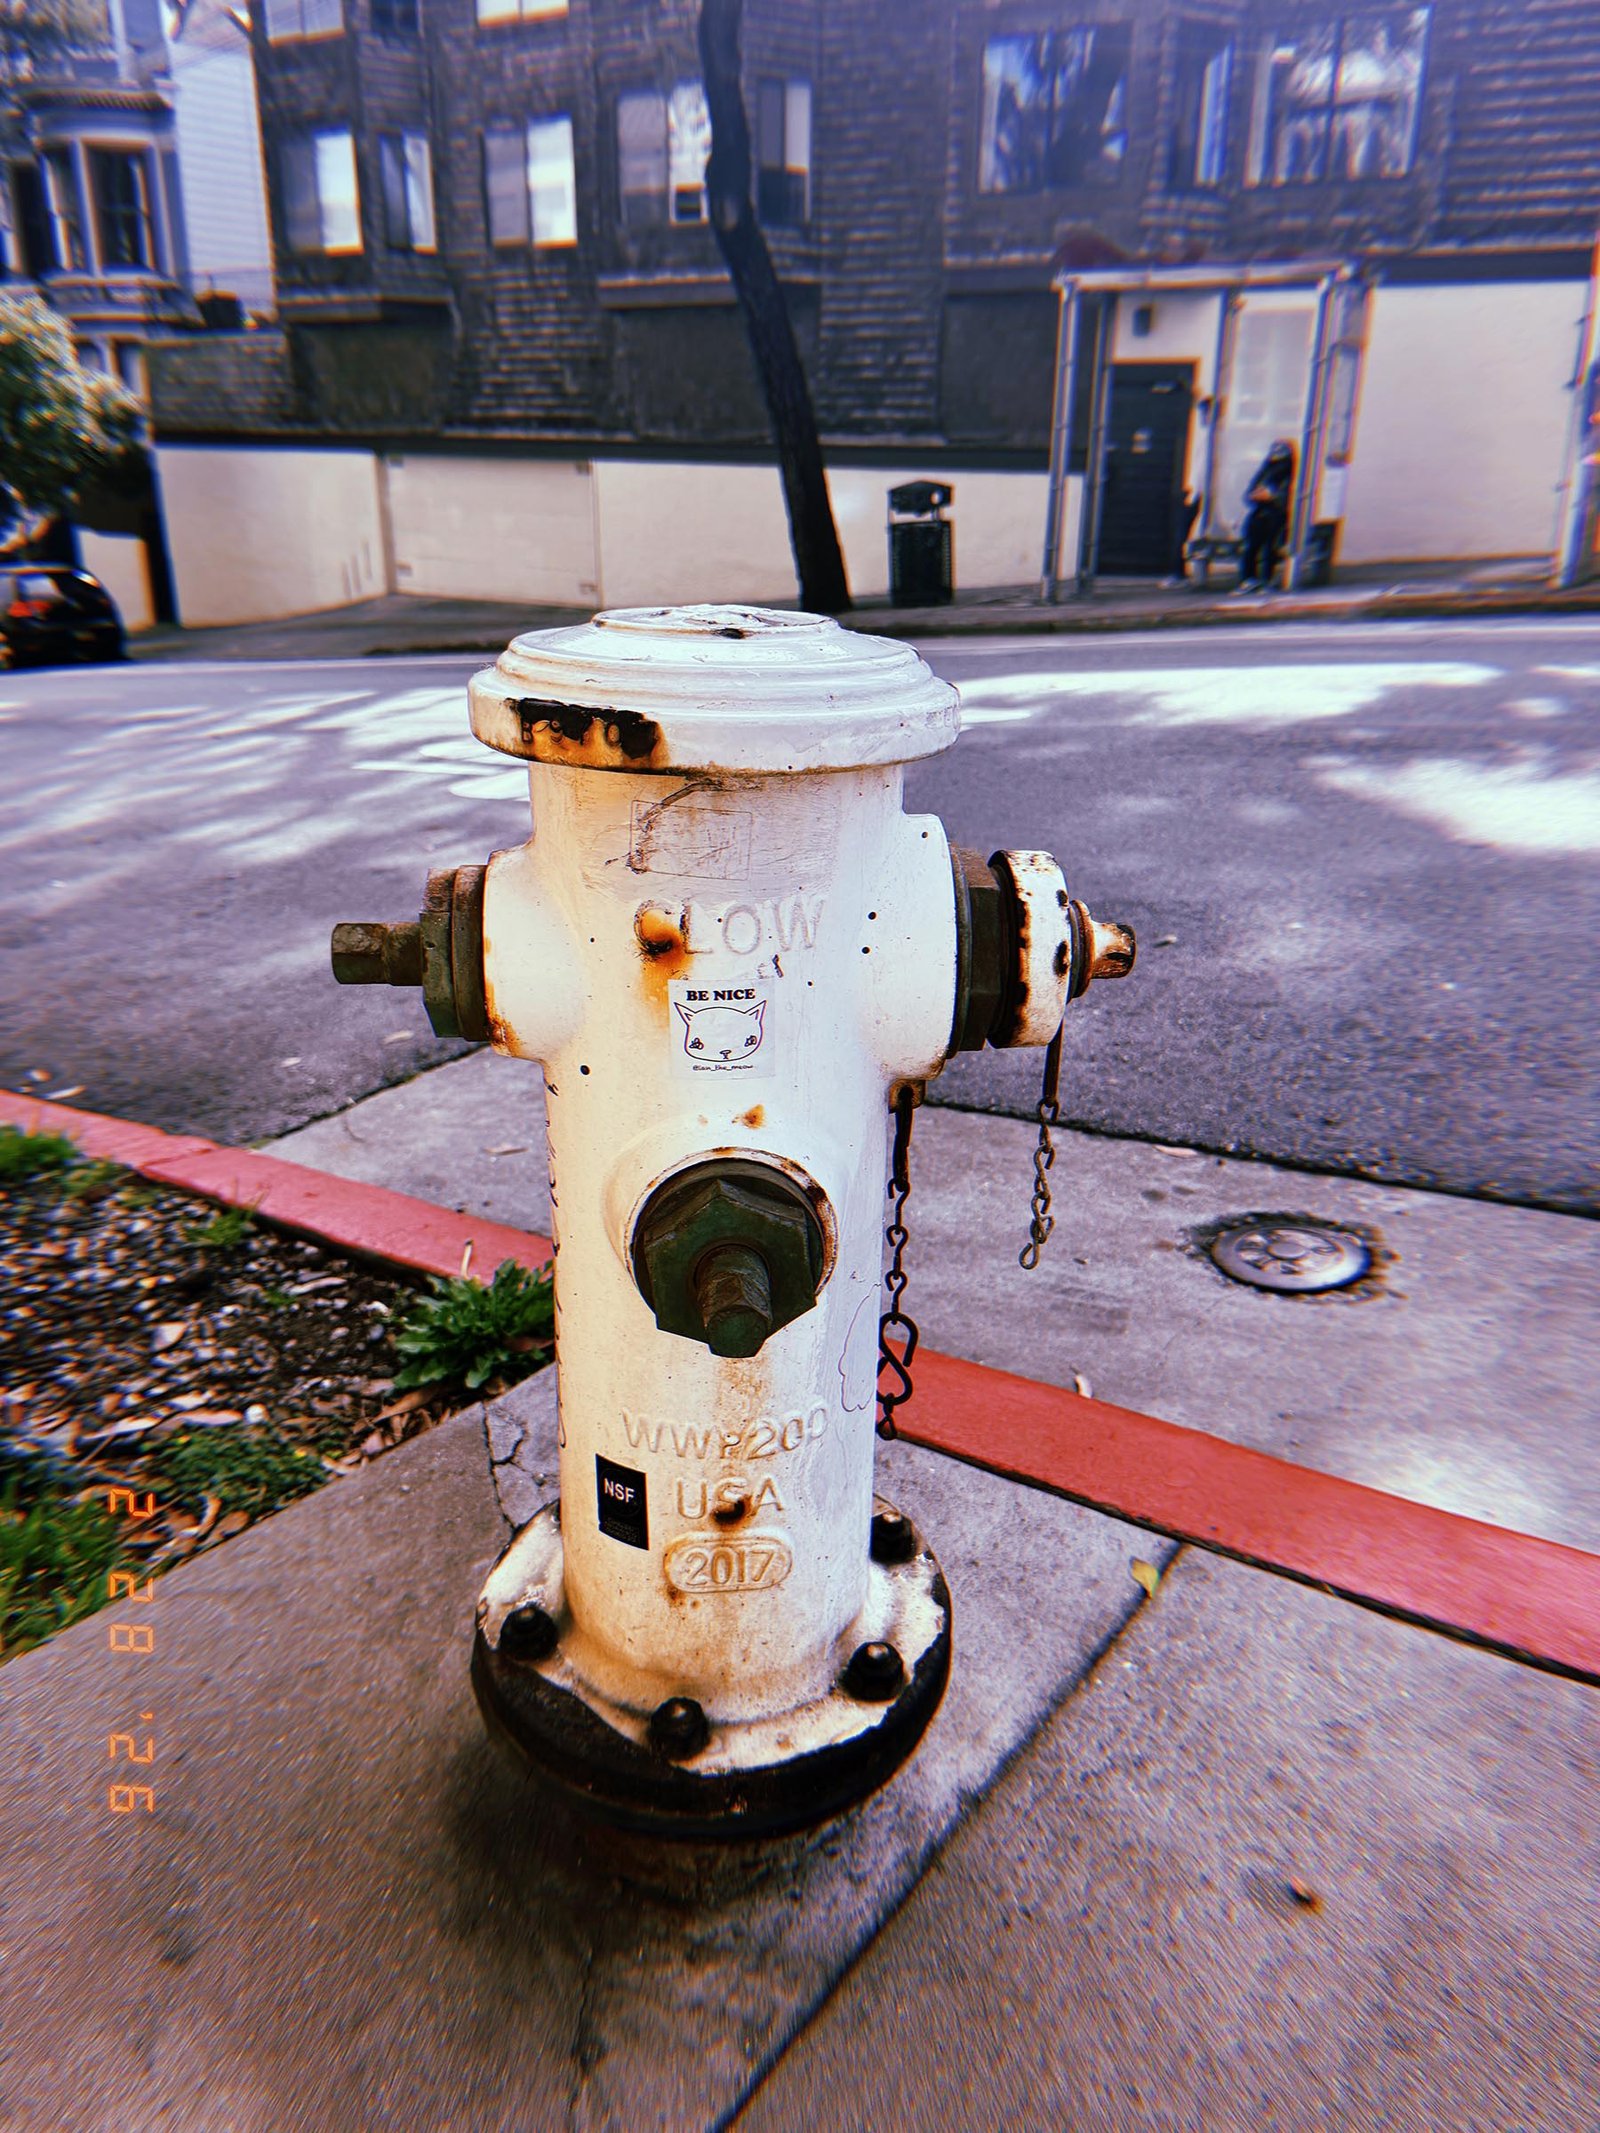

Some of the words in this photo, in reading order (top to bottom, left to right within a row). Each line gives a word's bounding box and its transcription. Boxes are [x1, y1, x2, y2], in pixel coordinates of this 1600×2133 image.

[634, 898, 825, 958] CLOW
[686, 990, 709, 1001] BE
[713, 988, 756, 1001] NICE
[603, 1477, 635, 1503] NSF
[676, 1476, 783, 1522] USA
[685, 1547, 775, 1586] 2017
